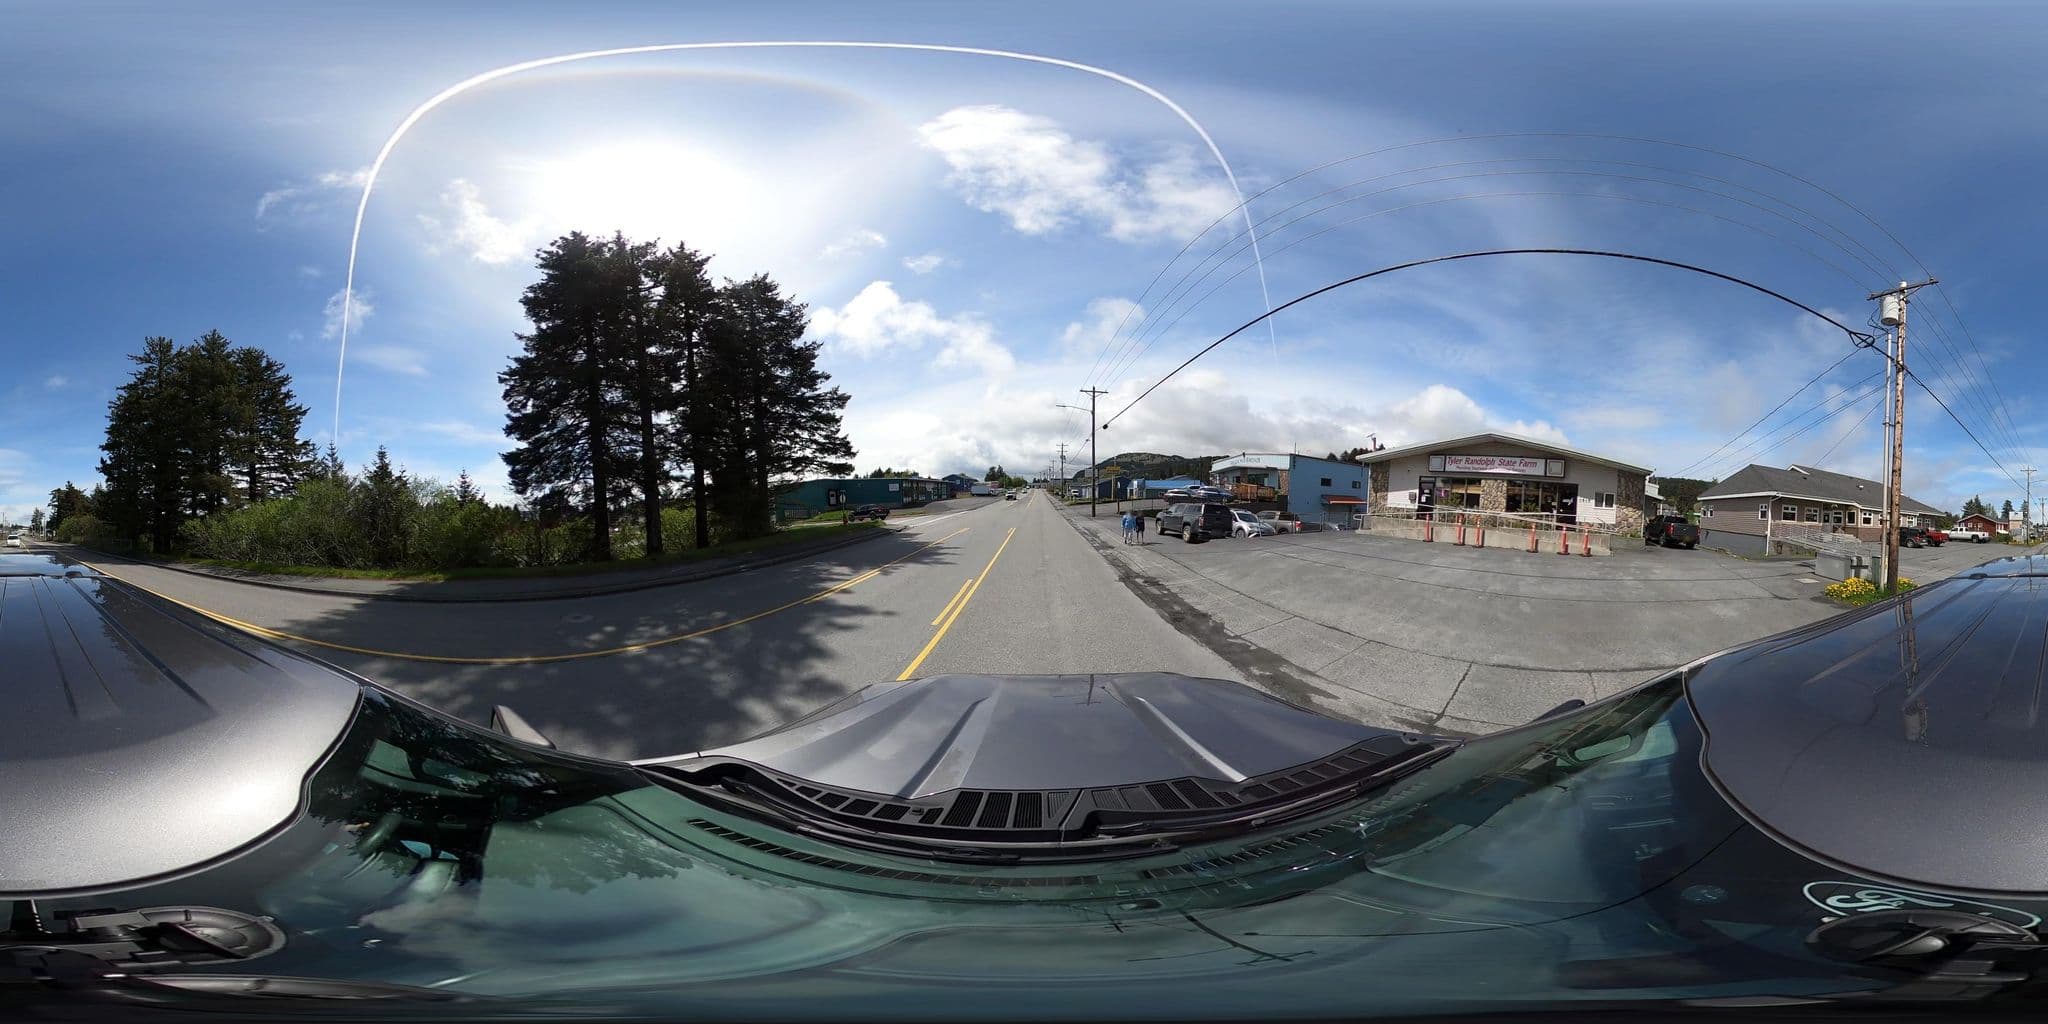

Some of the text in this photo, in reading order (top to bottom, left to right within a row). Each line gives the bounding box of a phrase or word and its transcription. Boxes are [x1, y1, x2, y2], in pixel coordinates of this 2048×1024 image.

[1448, 457, 1537, 468] Tyler Randolph State Farm
